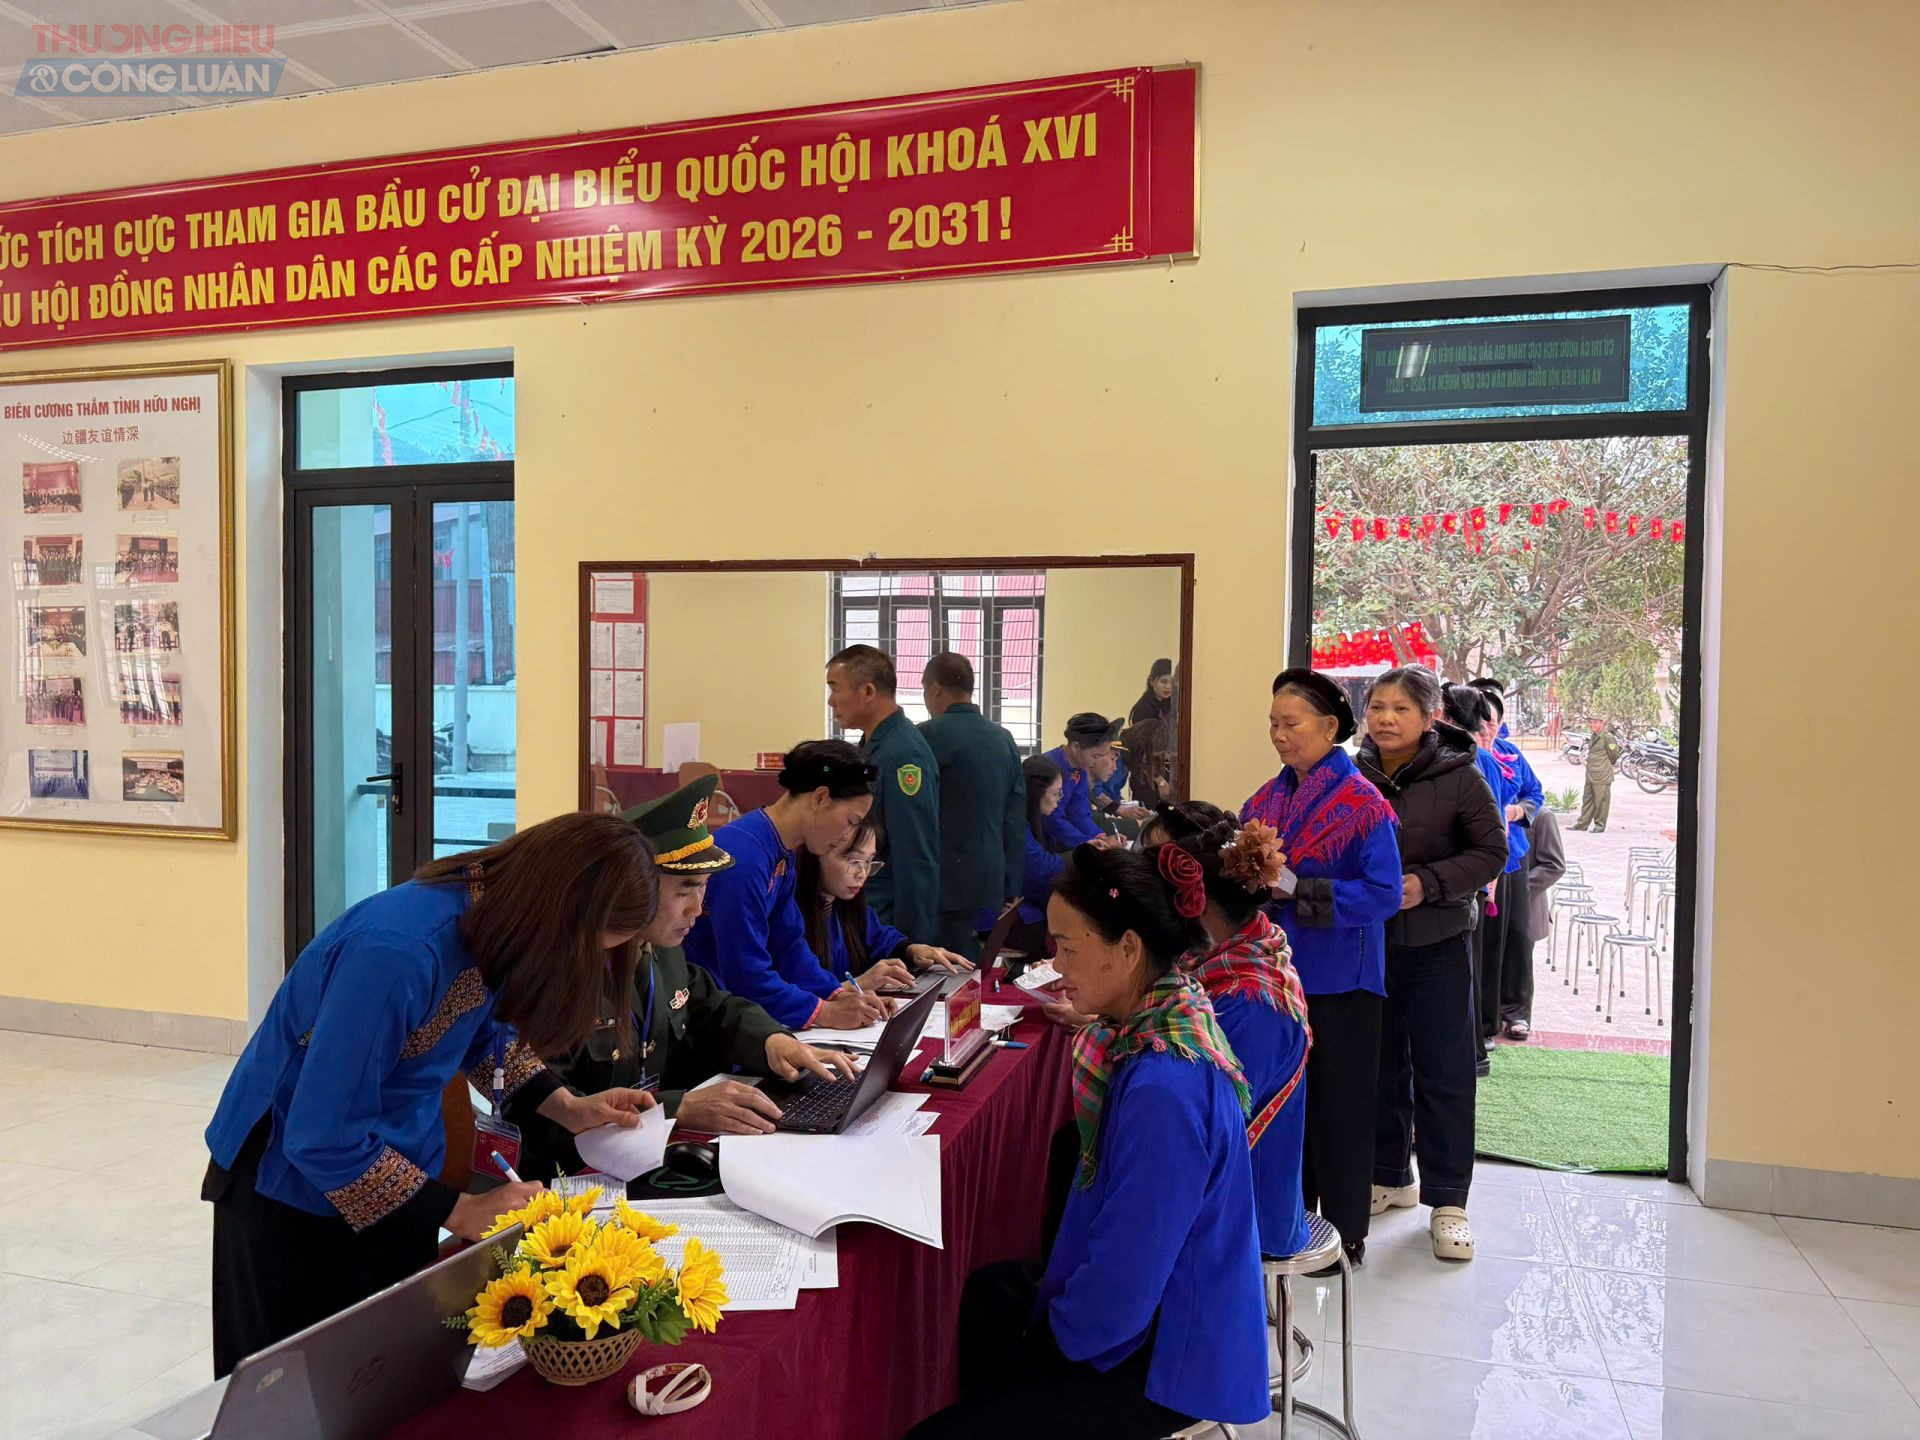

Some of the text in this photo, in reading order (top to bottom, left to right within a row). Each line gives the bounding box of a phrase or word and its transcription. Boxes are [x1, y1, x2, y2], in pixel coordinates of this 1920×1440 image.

[38, 221, 104, 266] TÍCH
[114, 214, 175, 262] CỰC
[185, 204, 277, 249] THAM
[288, 198, 345, 240] GIA
[356, 178, 426, 232] BẦU
[438, 165, 492, 223] CỬ
[498, 173, 560, 223] ĐẠI
[573, 147, 662, 209] BIỂU
[676, 135, 785, 203] QUỐC
[801, 132, 871, 193] HỘI
[887, 115, 1008, 178] KHOÁ
[1022, 112, 1097, 164] XVI
[31, 280, 79, 331] HỘI
[89, 269, 173, 320] ĐỒNG
[184, 262, 275, 311] NHÂN
[286, 254, 355, 302] DÂN
[367, 246, 437, 295] CÁC
[450, 231, 522, 288] CẤP
[536, 225, 662, 283] NHIỆM
[676, 215, 727, 268] KỲ
[741, 214, 842, 263] 2026
[857, 230, 873, 240] -
[4, 402, 31, 419] BIÊN
[34, 402, 73, 418] CƯƠNG
[113, 396, 140, 414] TÌNH
[144, 395, 168, 412] HỮU
[171, 396, 201, 414] NGHỊ
[62, 426, 139, 445] 边疆友谊情深
